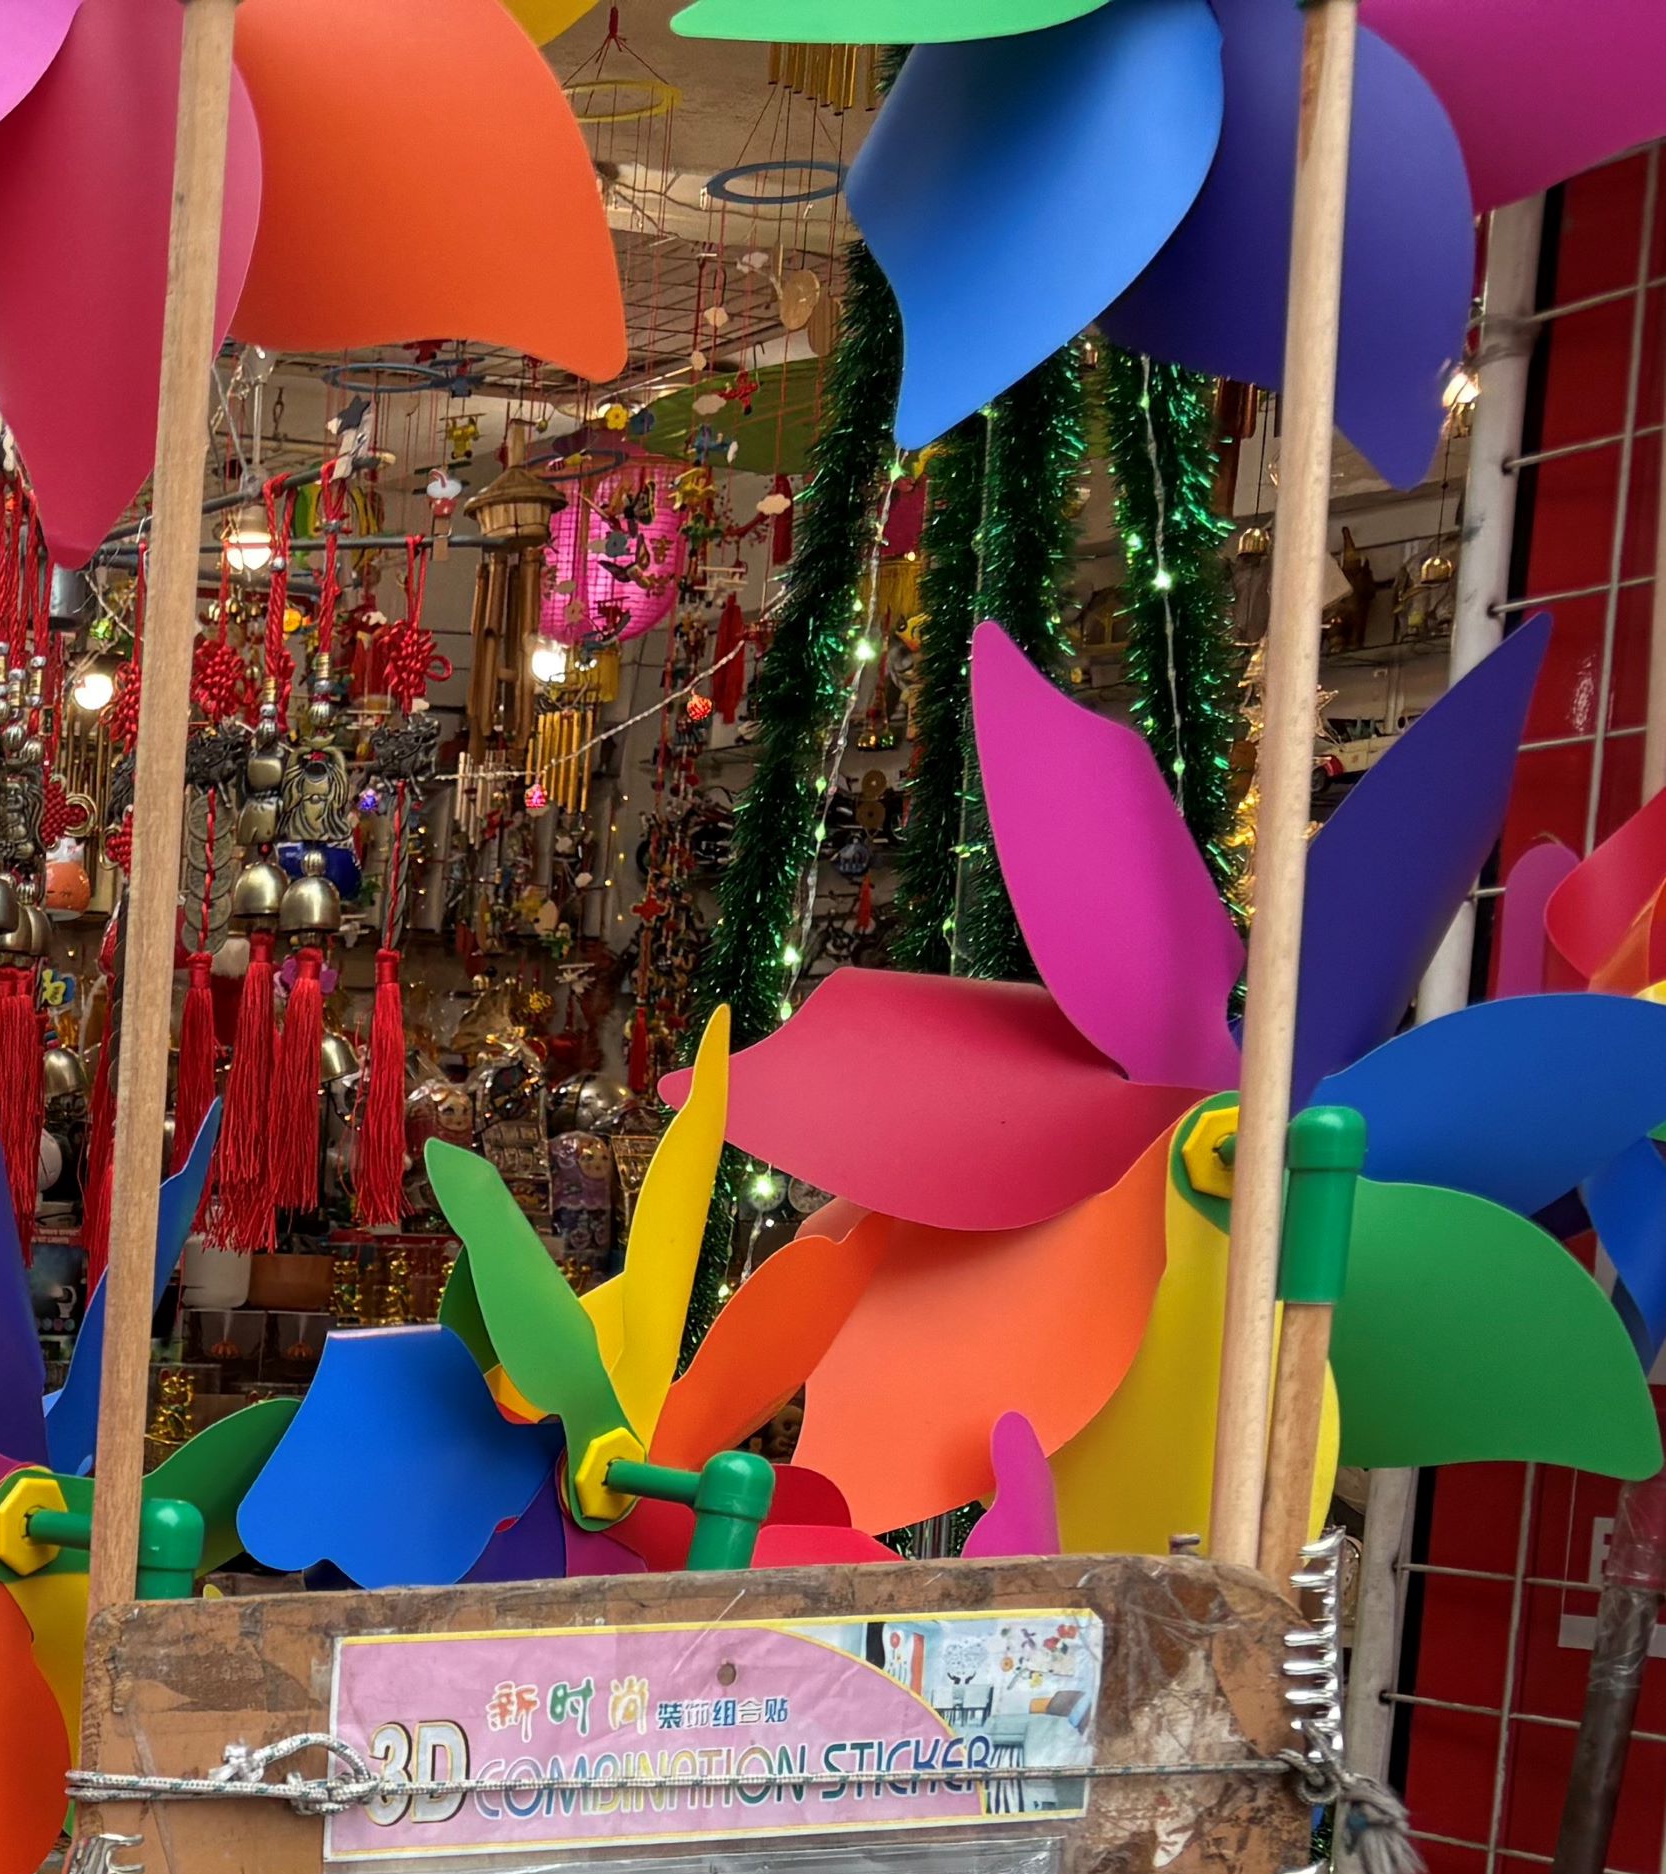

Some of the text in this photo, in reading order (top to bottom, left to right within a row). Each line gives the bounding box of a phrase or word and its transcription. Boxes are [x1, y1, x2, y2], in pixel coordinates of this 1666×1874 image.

[486, 1675, 650, 1743] 新时尚
[368, 1720, 995, 1827] 3D COMBINATION STICKER
